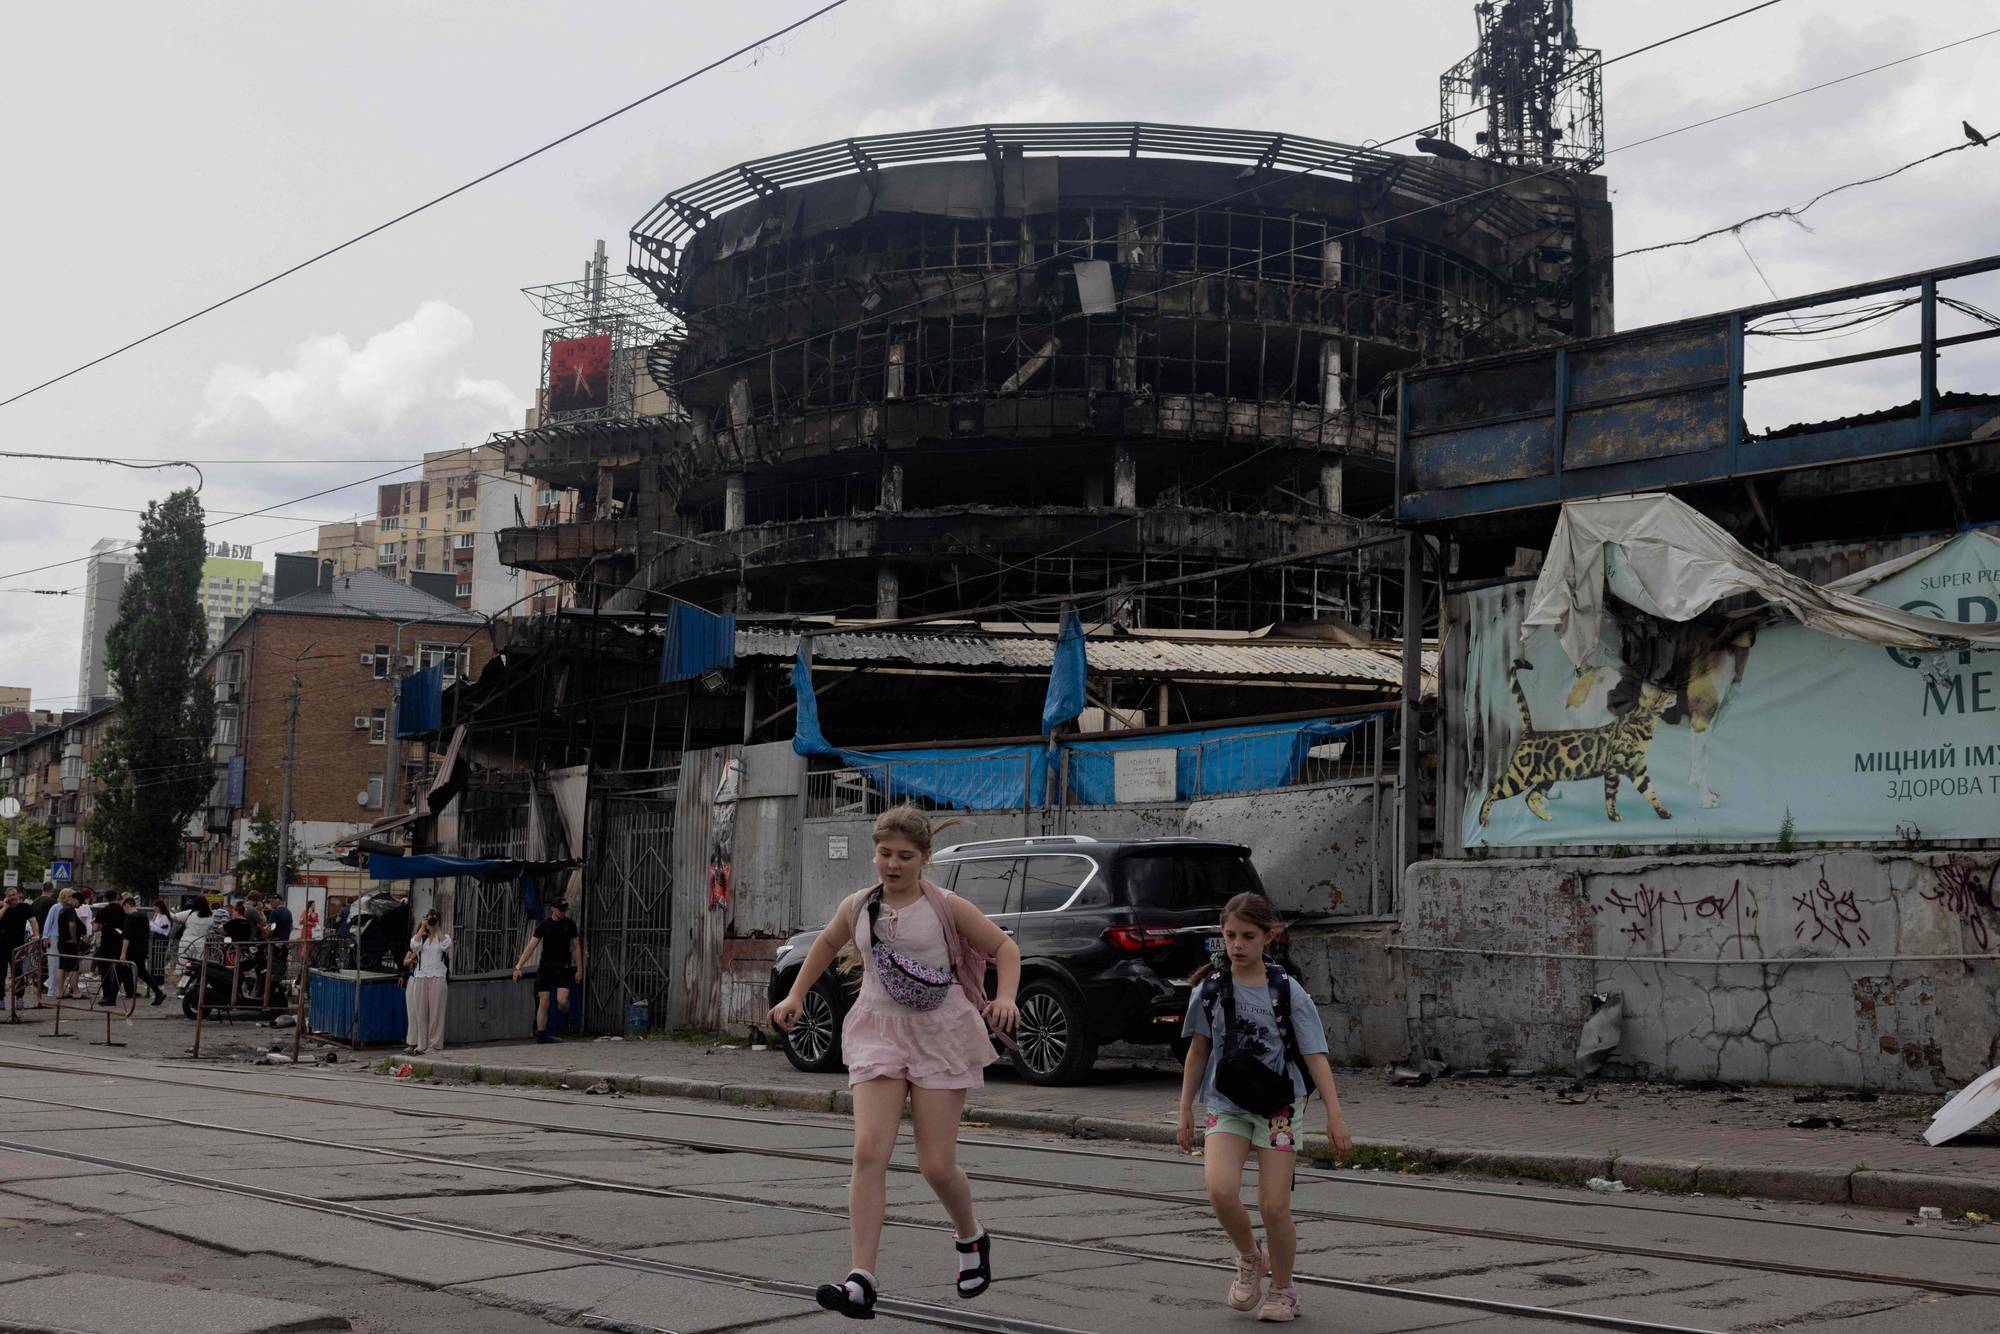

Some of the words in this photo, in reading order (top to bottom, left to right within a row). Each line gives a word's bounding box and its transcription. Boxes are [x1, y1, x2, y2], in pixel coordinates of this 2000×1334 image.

[232, 544, 252, 559] БУД
[1920, 572, 1972, 590] SUPER
[1922, 671, 2000, 717] ME
[1854, 743, 1956, 775] МІЦНИЙ
[1887, 776, 1984, 802] ЗДОРОВА
